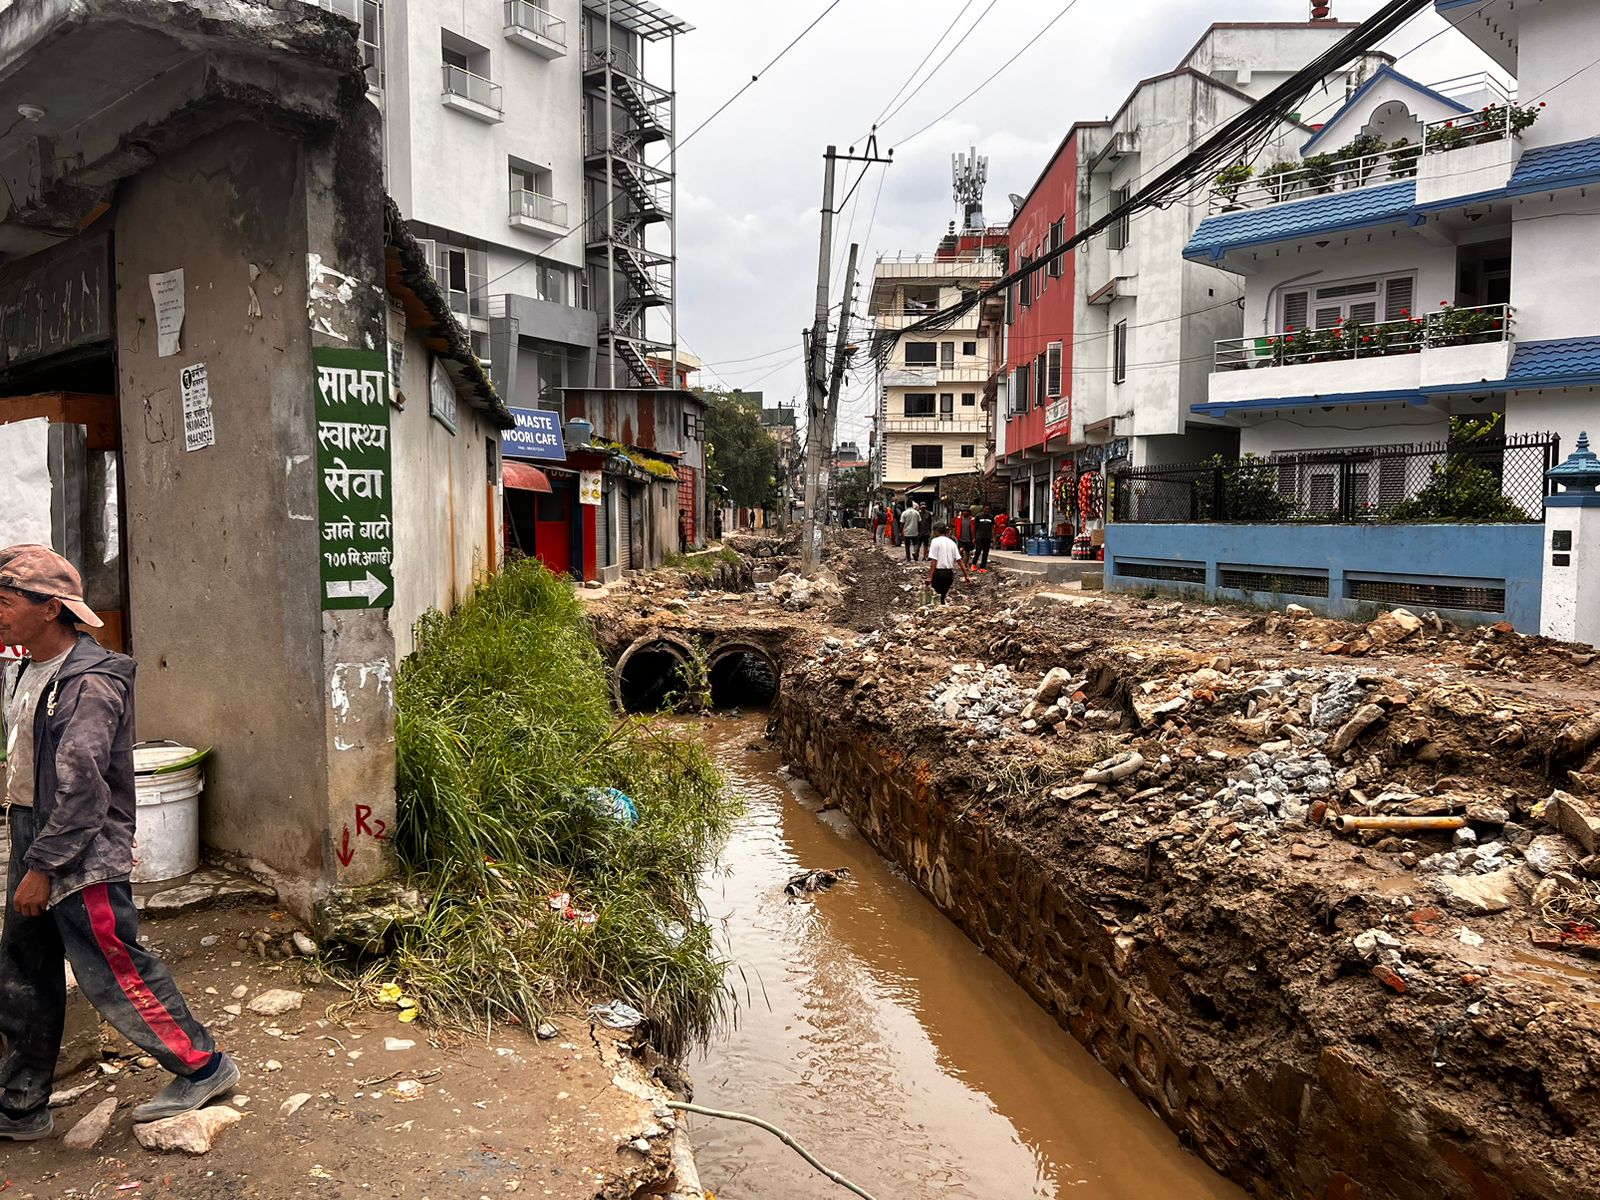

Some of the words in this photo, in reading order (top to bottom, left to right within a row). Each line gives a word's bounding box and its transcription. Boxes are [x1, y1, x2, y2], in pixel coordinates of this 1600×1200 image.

[318, 421, 388, 455] स्वास्थ्य
[502, 430, 534, 443] WOORI
[536, 433, 557, 445] CAFE
[323, 457, 385, 503] सेवा
[322, 515, 356, 541] जाने
[359, 514, 392, 540] बाटो
